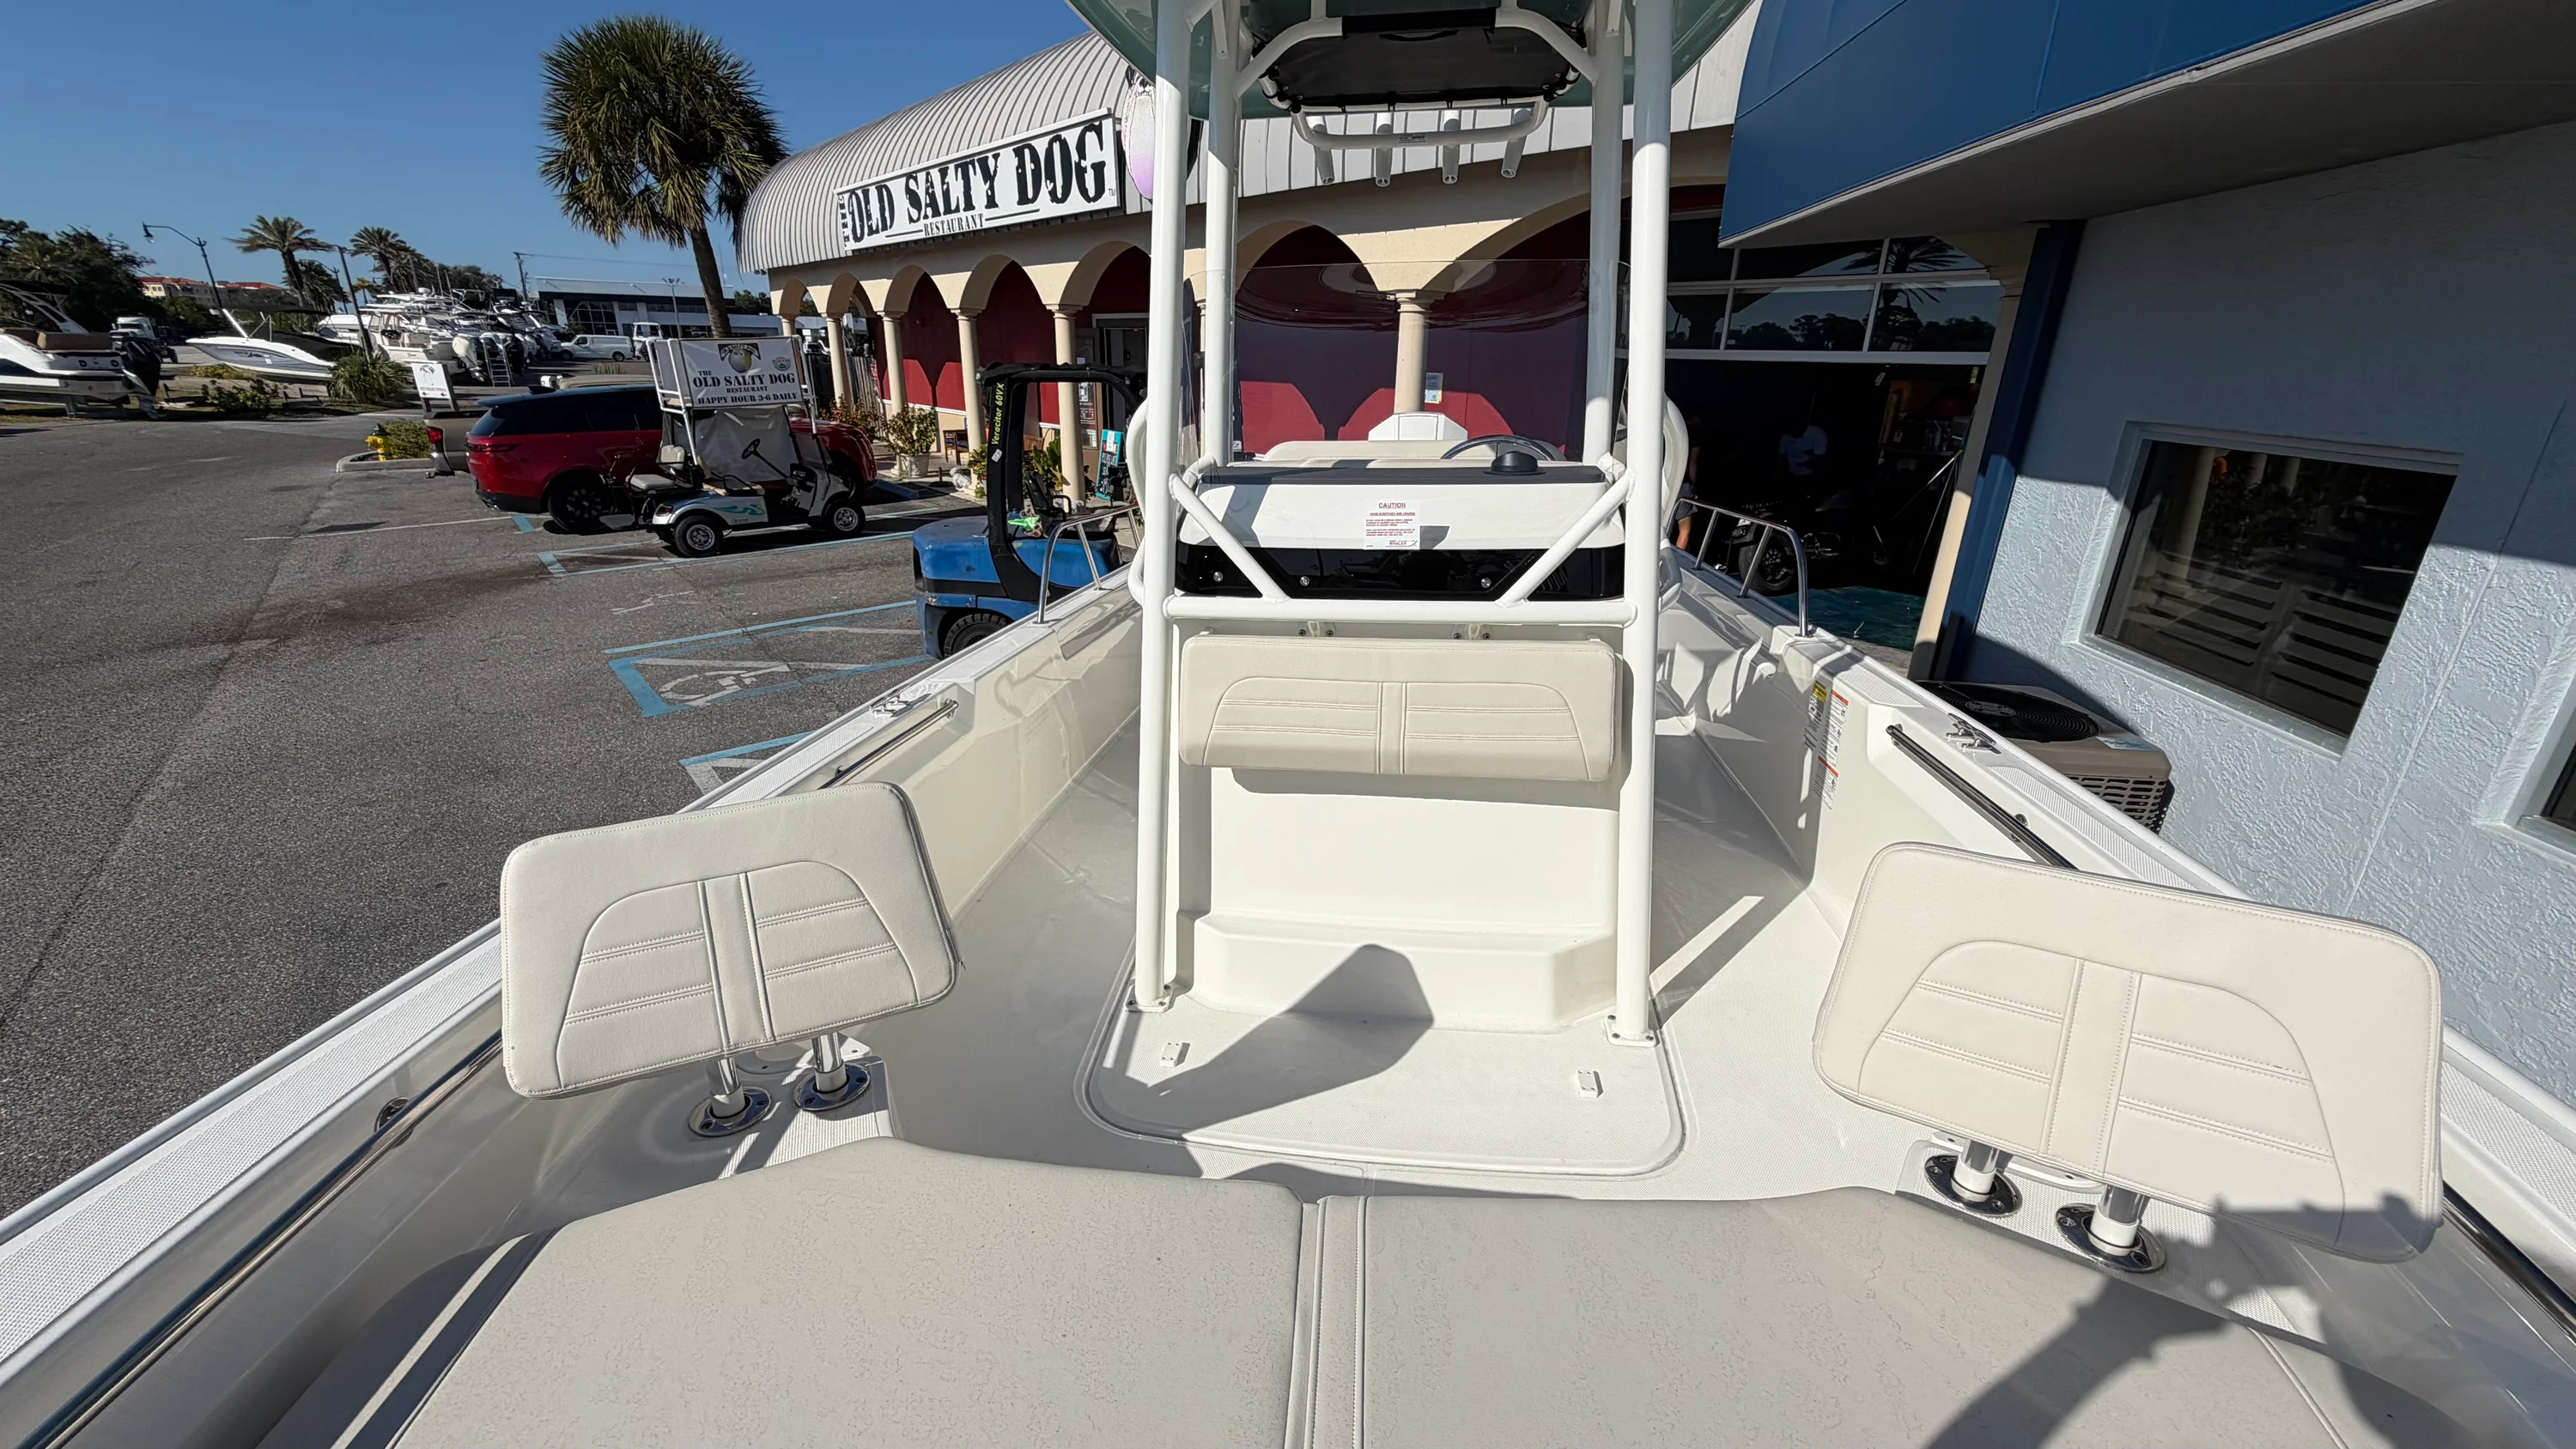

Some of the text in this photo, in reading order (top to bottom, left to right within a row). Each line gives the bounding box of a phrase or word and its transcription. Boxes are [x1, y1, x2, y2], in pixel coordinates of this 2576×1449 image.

[848, 184, 895, 244] OLD
[905, 152, 1000, 225] SALTY
[1012, 120, 1107, 206] DOG
[924, 213, 985, 237] RESTAURANT
[693, 373, 796, 388] OLD SALTY DOG
[773, 392, 798, 401] DAILY
[995, 382, 1005, 406] 60VX
[991, 408, 1003, 445] Veracitor
